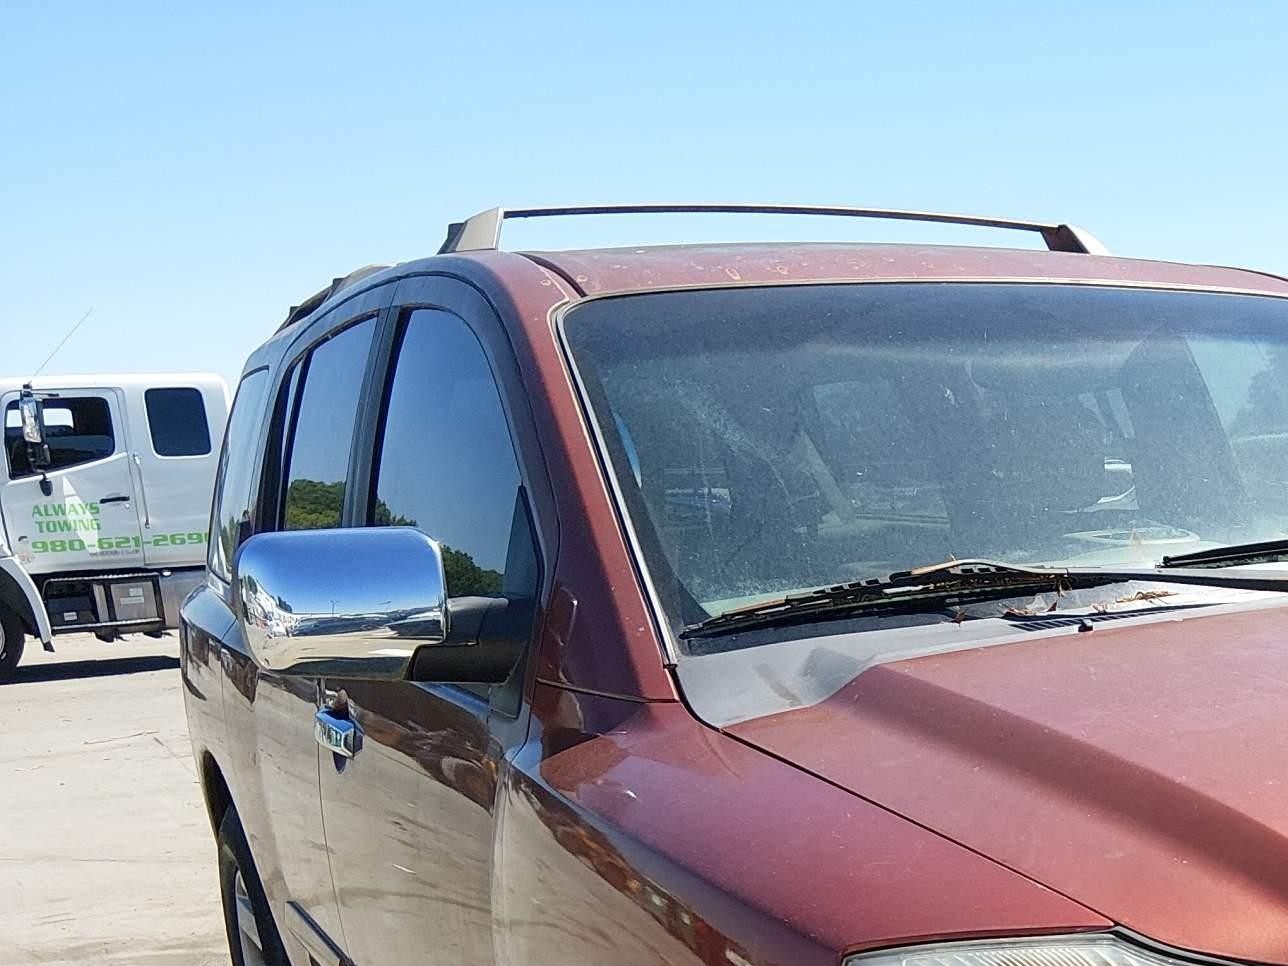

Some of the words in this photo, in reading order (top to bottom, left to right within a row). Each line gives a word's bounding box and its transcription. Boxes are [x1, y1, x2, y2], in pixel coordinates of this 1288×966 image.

[33, 503, 100, 517] ALWAYS
[35, 518, 101, 533] TOWING
[31, 532, 209, 553] 980-621-269
